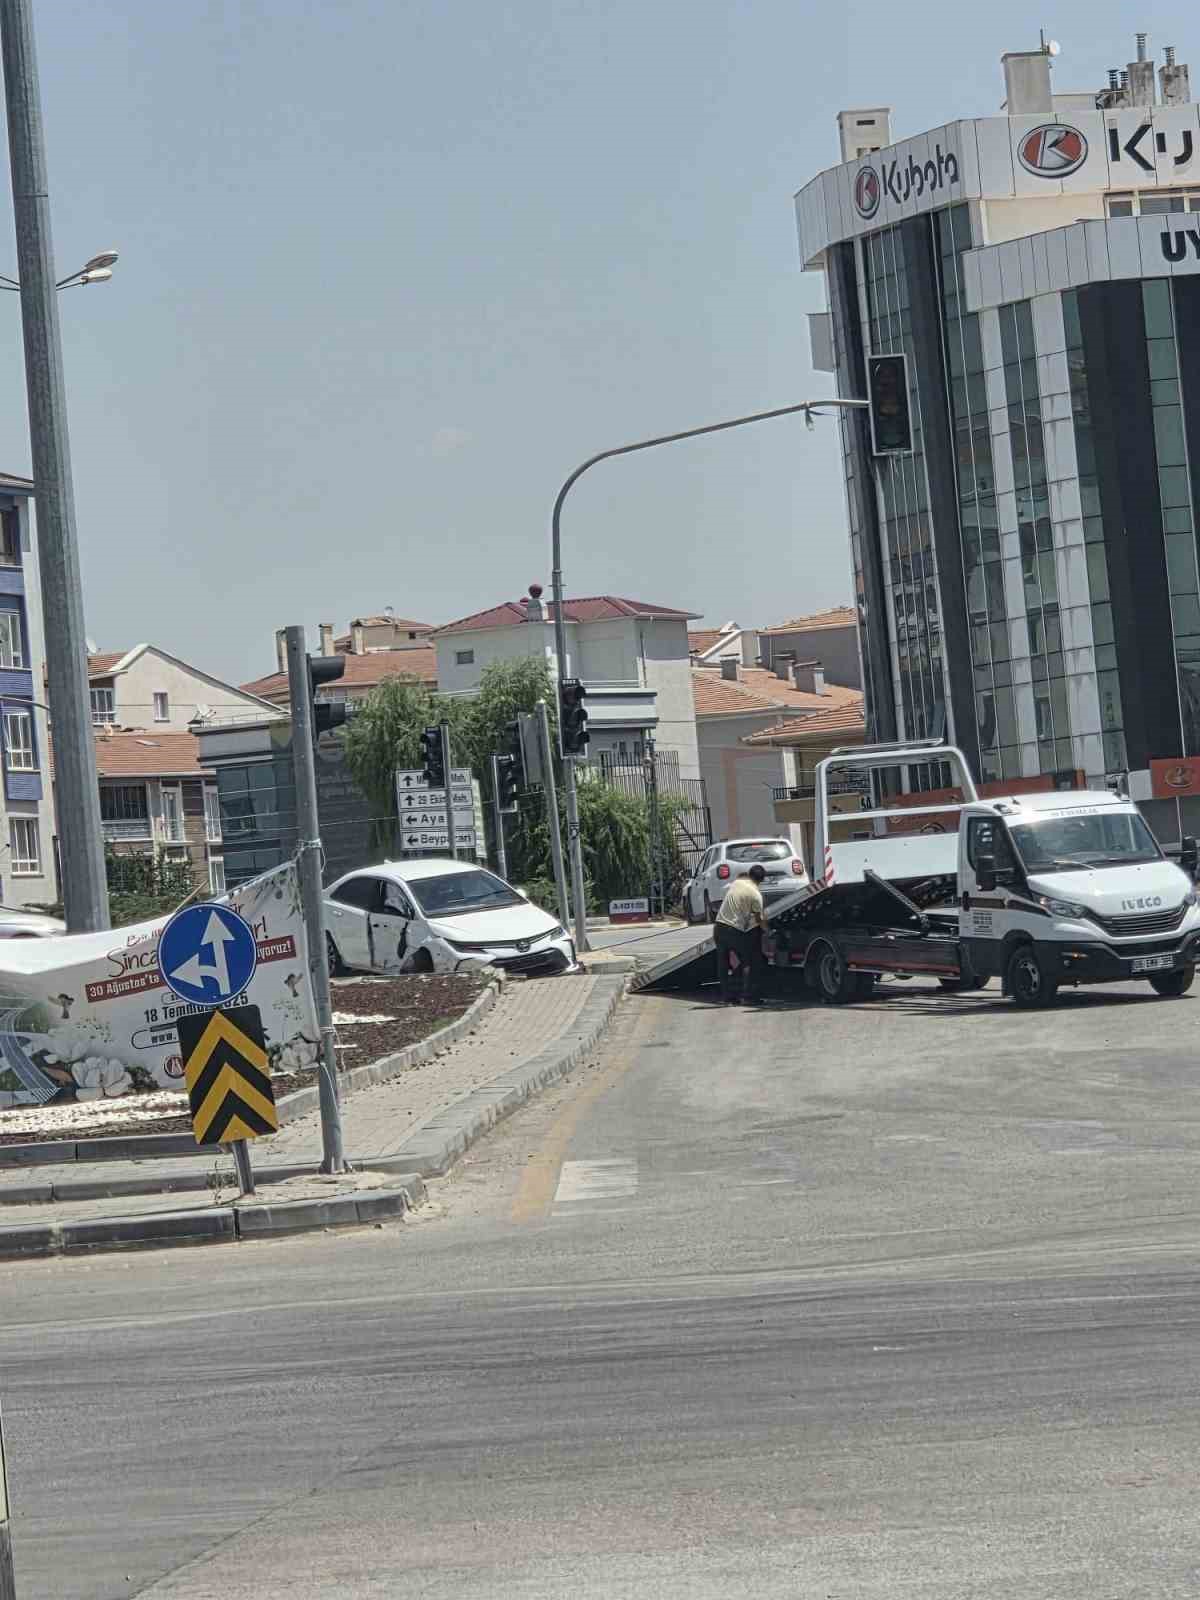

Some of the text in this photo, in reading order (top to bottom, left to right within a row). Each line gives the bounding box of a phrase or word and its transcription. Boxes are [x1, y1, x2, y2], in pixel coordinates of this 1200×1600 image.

[881, 143, 960, 204] Kubota
[420, 814, 449, 826] Aya
[1121, 895, 1162, 911] IVECO
[106, 947, 157, 978] Sinca
[89, 984, 104, 998] 30
[144, 1008, 158, 1024] 18
[161, 1002, 209, 1021] Temmu
